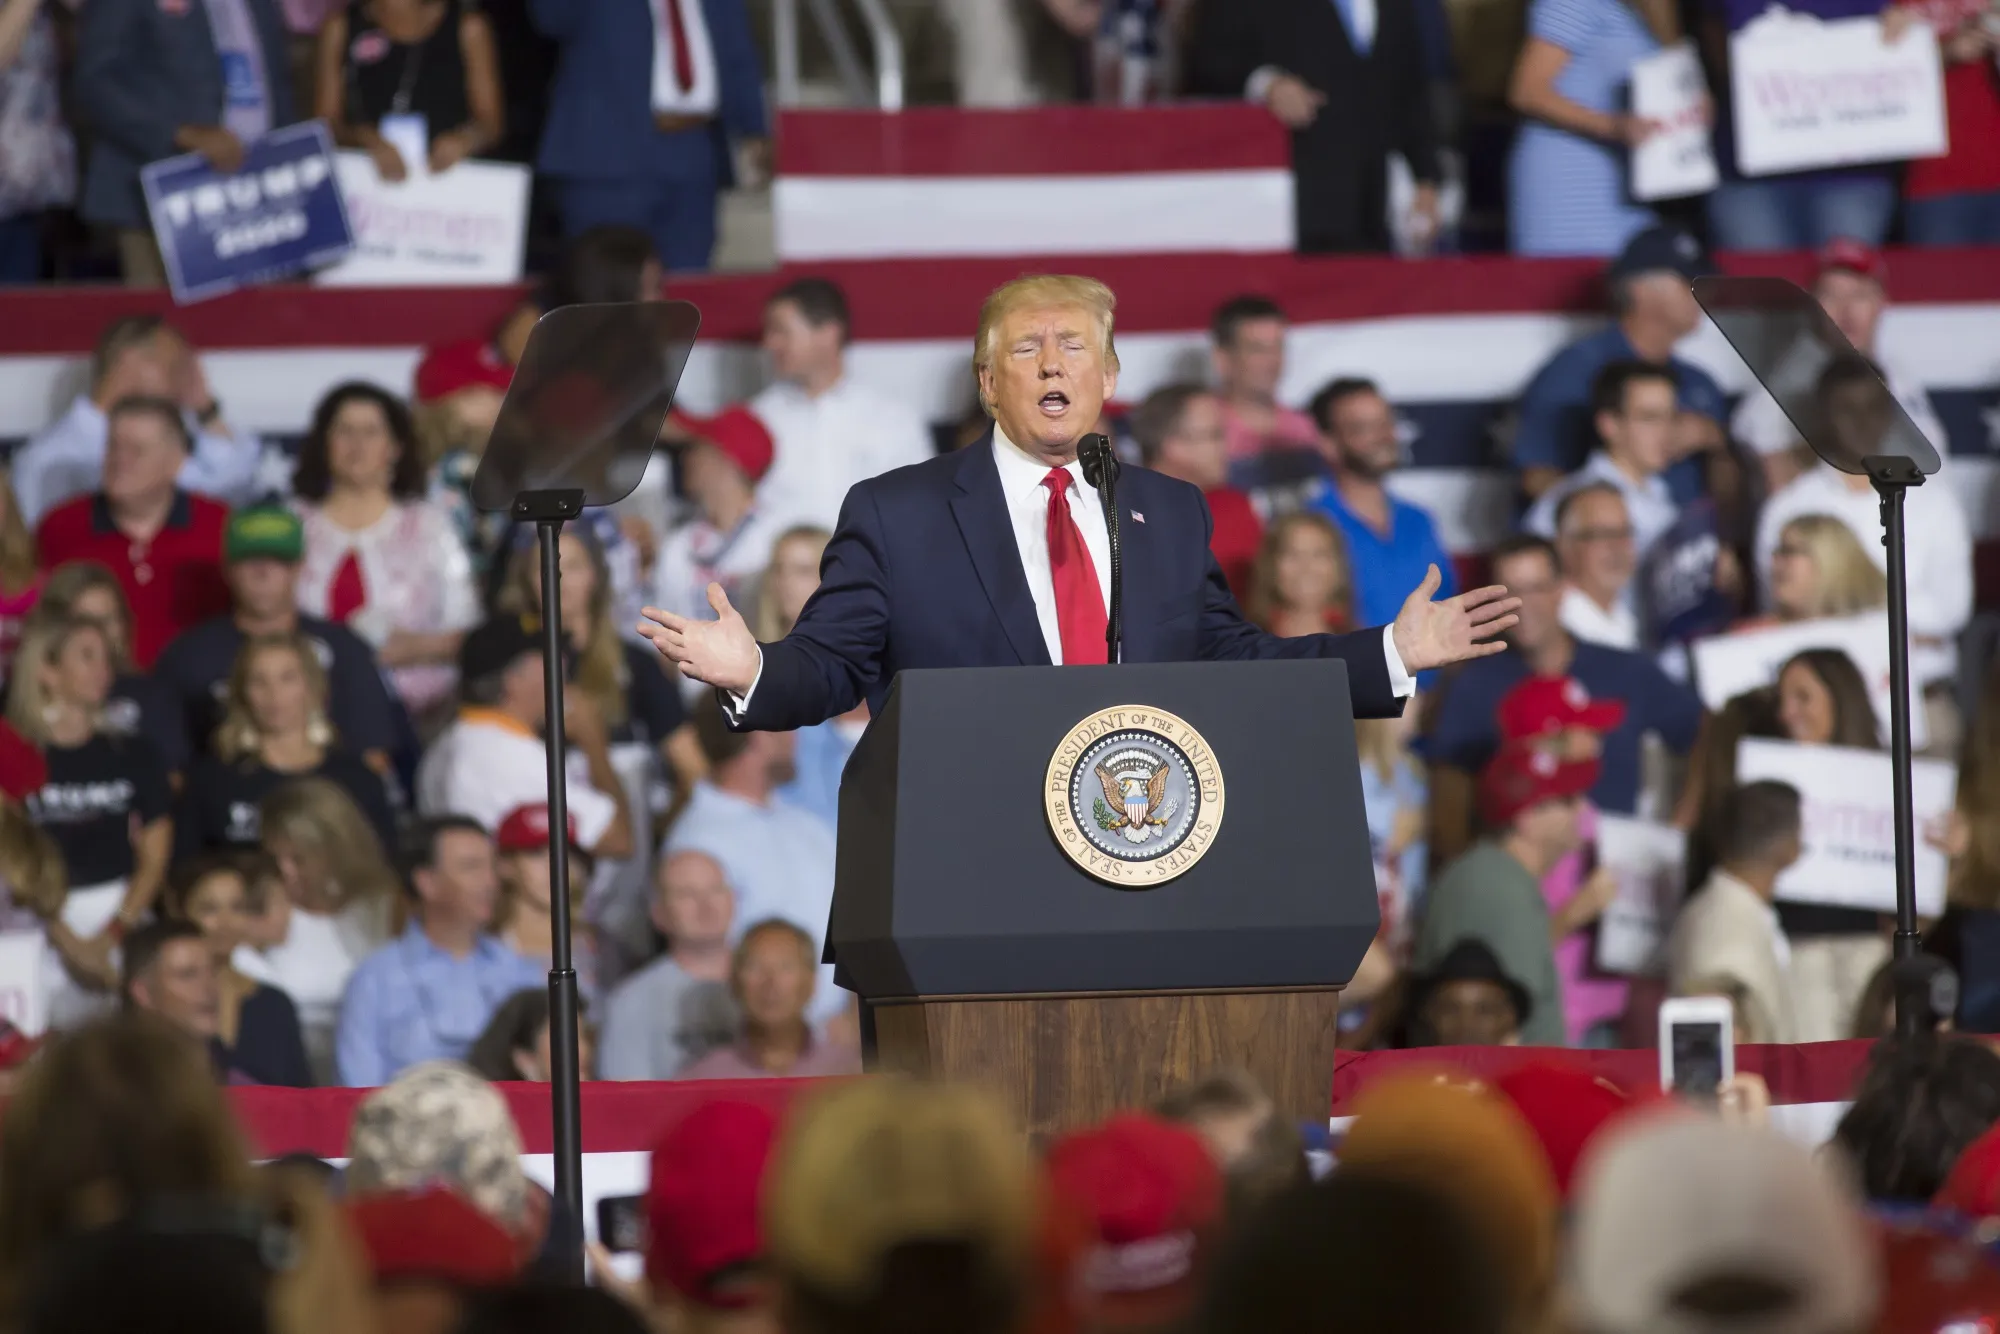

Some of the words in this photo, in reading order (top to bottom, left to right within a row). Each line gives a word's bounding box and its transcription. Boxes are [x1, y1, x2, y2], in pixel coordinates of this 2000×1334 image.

[164, 156, 325, 228] TRUMP
[1131, 713, 1148, 725] OF
[1151, 716, 1174, 733] THE
[1052, 712, 1126, 793] PRESIDENT
[1178, 730, 1218, 803] UNITED
[1055, 800, 1069, 825] THE
[1063, 827, 1077, 842] OF
[1154, 819, 1212, 876] STATES
[1078, 840, 1123, 877] SEAL
